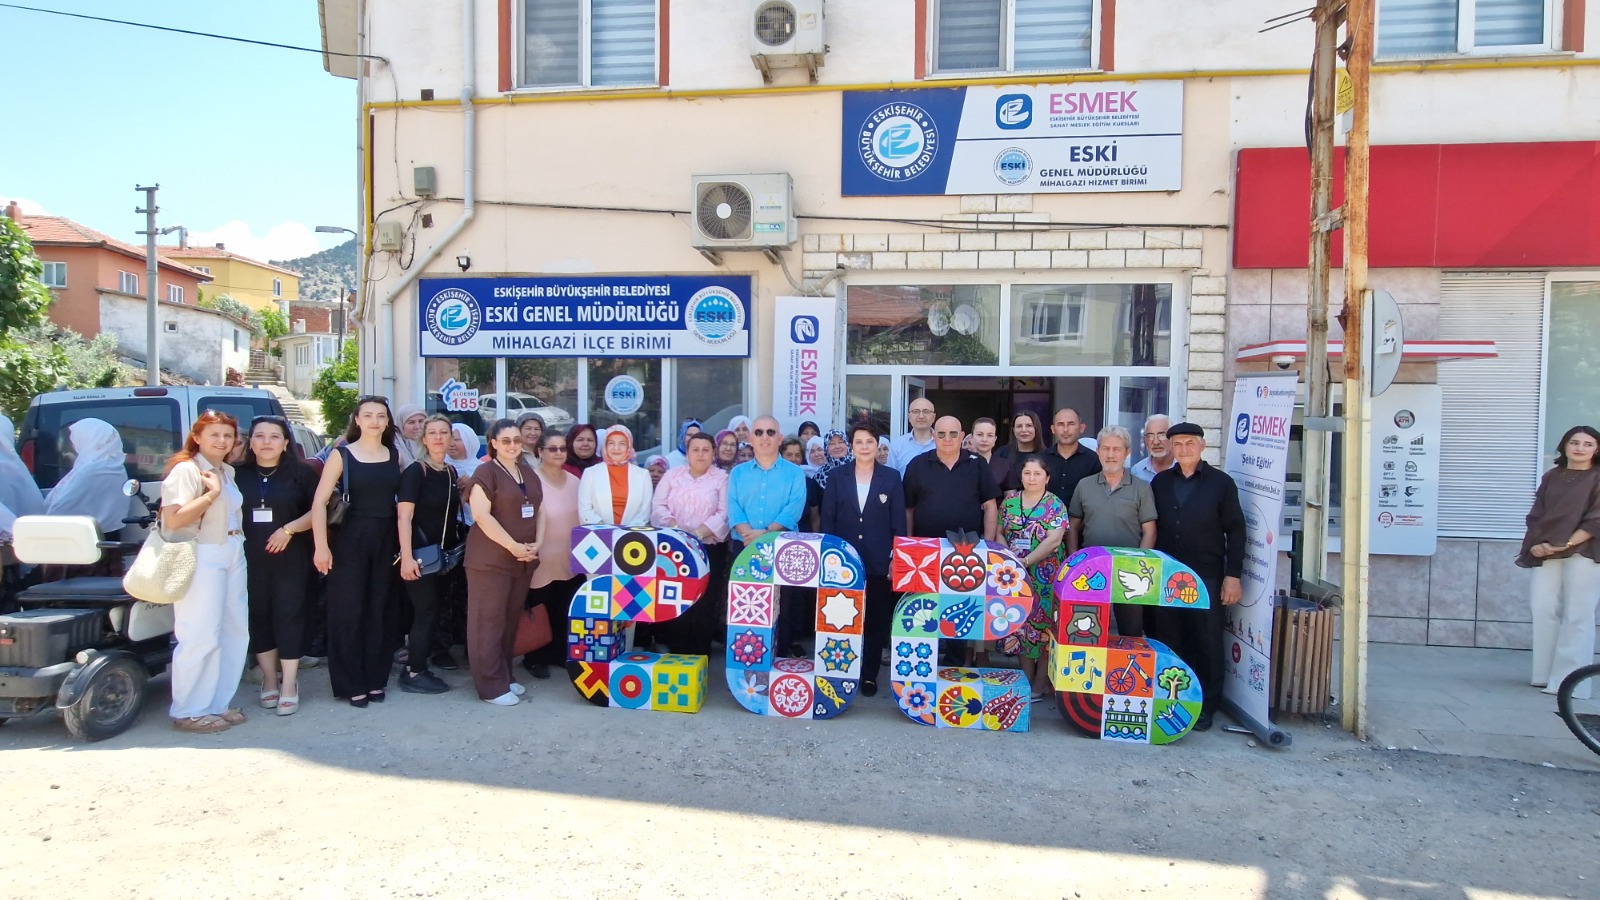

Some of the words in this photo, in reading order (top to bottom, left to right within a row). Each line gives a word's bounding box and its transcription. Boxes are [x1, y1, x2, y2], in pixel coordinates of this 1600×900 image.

[1049, 90, 1138, 114] ESMEK
[873, 105, 923, 123] ESKİŞEHİR
[861, 130, 900, 178] BÜYÜKŞEHİR
[904, 128, 936, 177] BELEDİYESİ
[1070, 140, 1118, 162] ESKİ
[1001, 160, 1026, 170] ESKİ
[1040, 168, 1074, 178] GENEL
[1077, 164, 1148, 176] MÜDÜRLÜĞÜ
[1040, 178, 1086, 187] MİHALGAZİ
[1088, 178, 1118, 186] HİZMET
[1121, 178, 1148, 186] BİRİMİ
[436, 290, 470, 304] ESKİŞEHİR
[494, 286, 544, 298] ESKİŞEHİR
[546, 284, 611, 298] BÜYÜKŞEHİR
[612, 284, 670, 296] BELEDİYESİ
[485, 303, 518, 323] ESKİ
[523, 306, 572, 322] GENEL
[578, 301, 680, 322] MÜDÜRLÜĞÜ
[696, 308, 732, 322] ESKİ
[492, 332, 576, 350] MİHALGAZİ
[583, 332, 614, 353] İLÇE
[621, 332, 672, 350] BİRİMİ
[800, 349, 818, 416] ESMEK
[612, 389, 636, 399] ESKİ
[452, 398, 477, 408] 185
[1252, 416, 1287, 437] ESMEK
